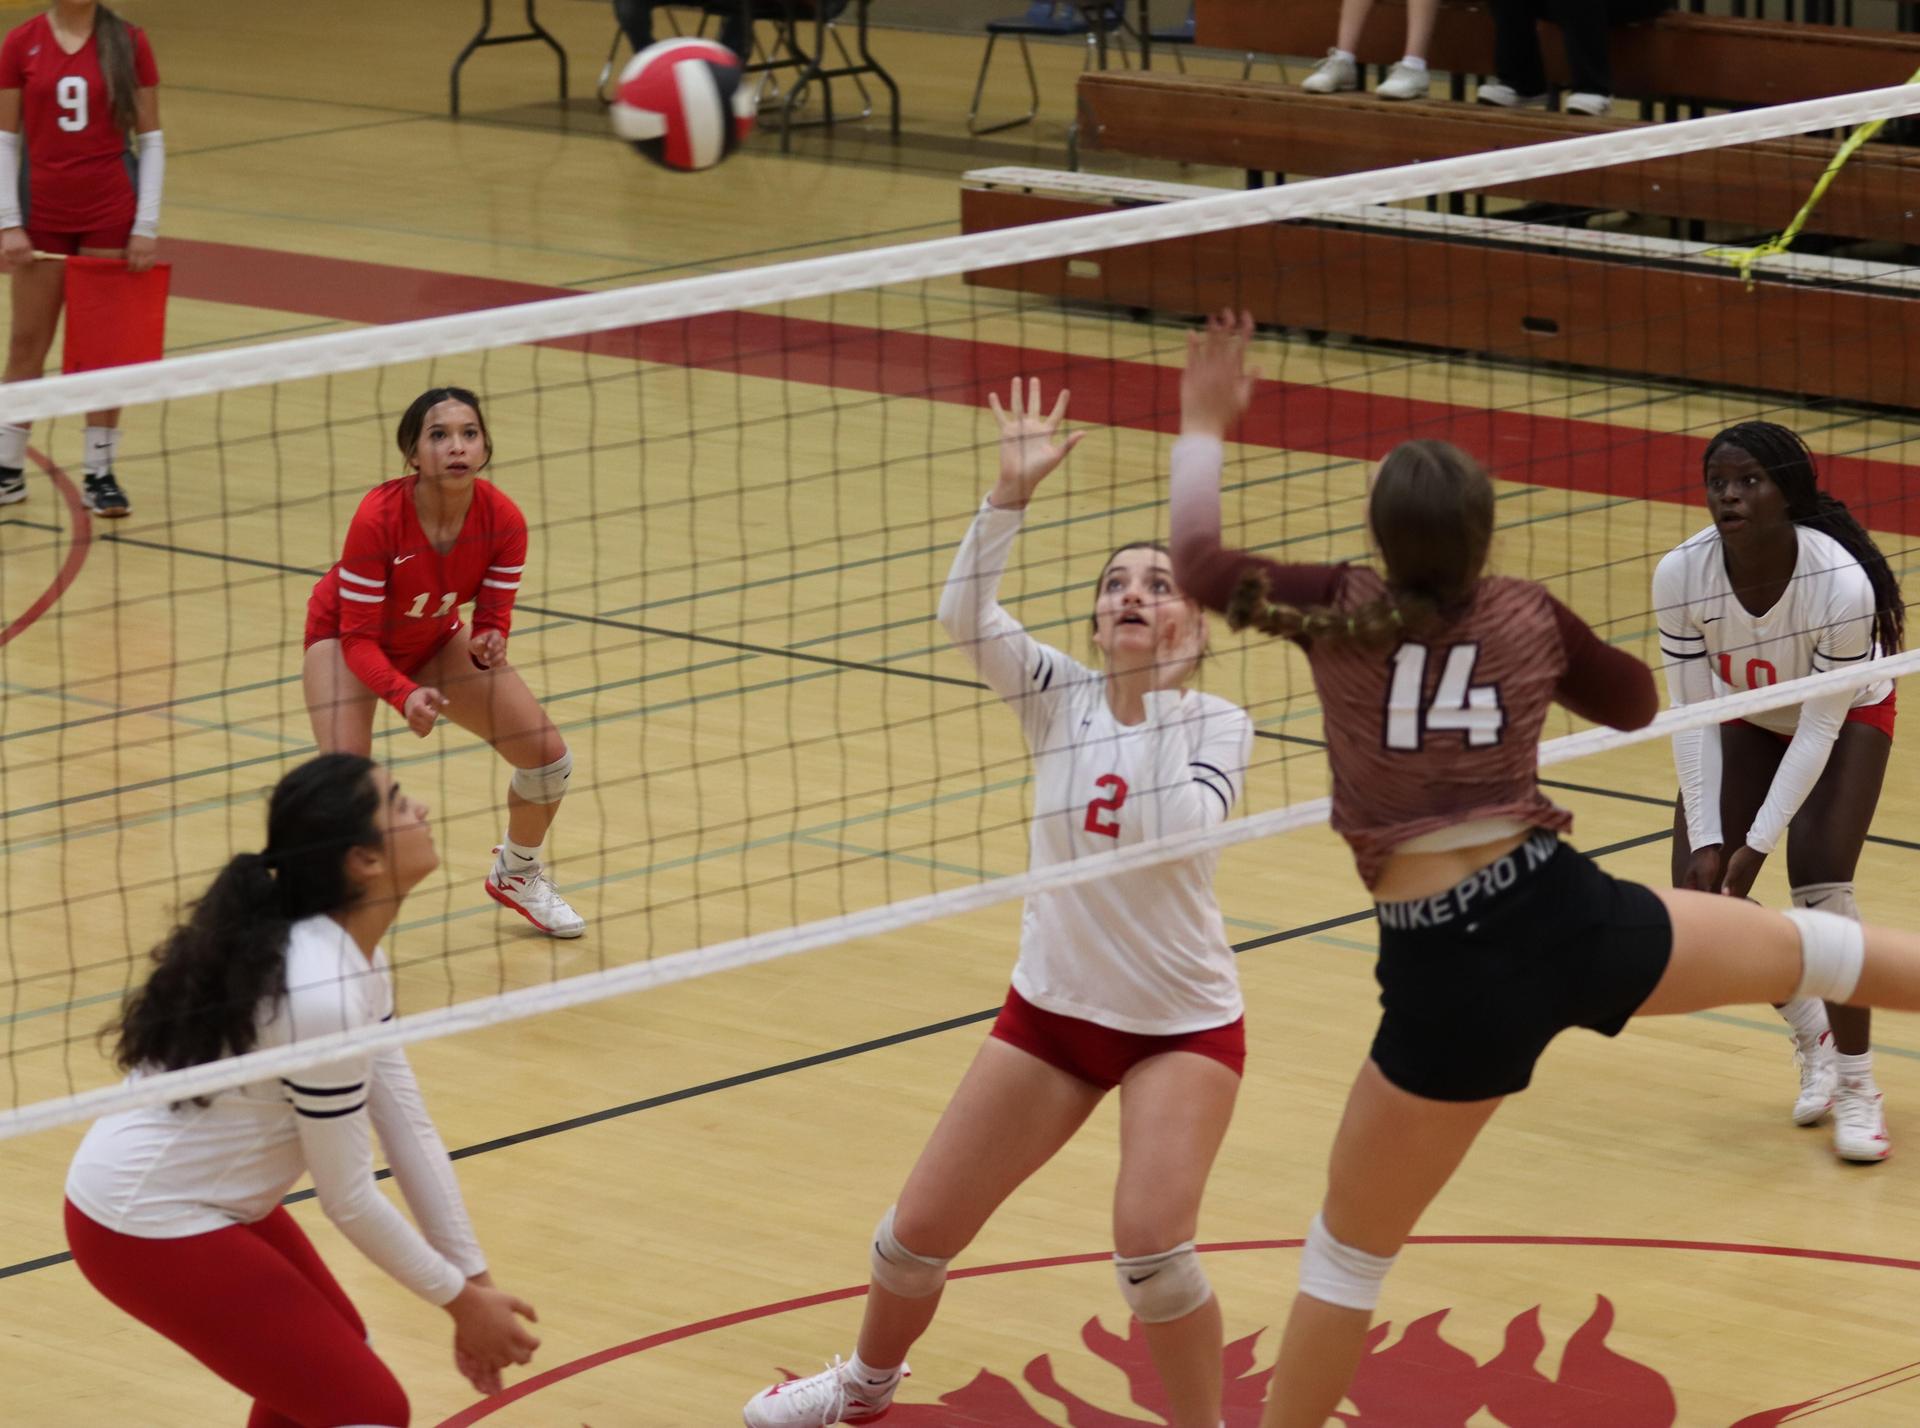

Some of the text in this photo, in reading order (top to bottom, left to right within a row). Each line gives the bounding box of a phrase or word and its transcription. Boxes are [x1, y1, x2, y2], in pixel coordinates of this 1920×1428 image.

[57, 75, 89, 132] 9
[403, 591, 458, 618] 11
[1384, 640, 1505, 751] 14
[1084, 773, 1129, 839] 2
[1378, 891, 1455, 931] NIKE
[1454, 856, 1518, 914] PRO
